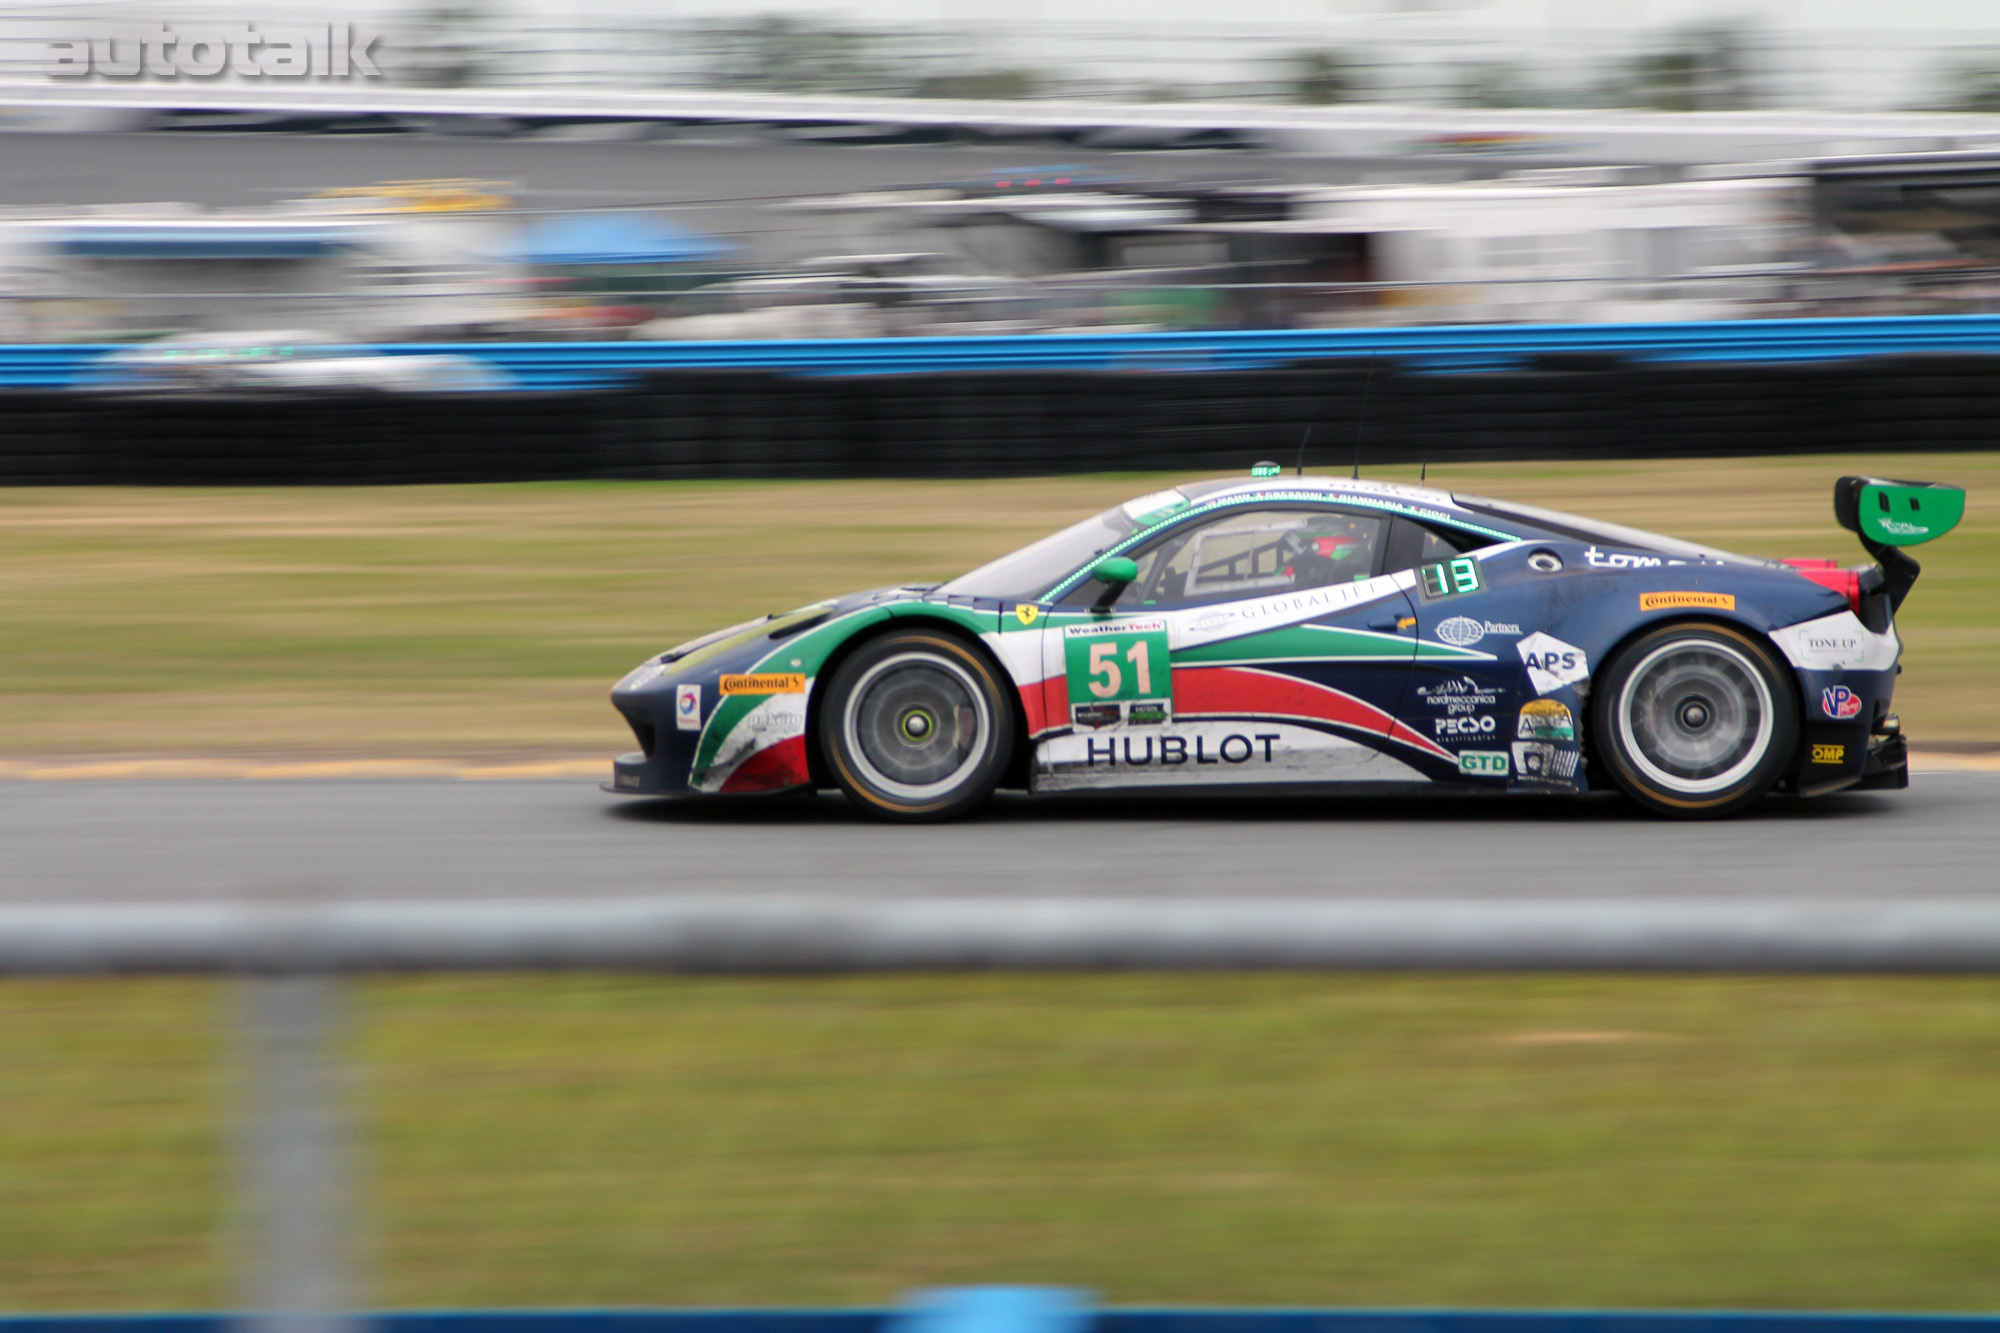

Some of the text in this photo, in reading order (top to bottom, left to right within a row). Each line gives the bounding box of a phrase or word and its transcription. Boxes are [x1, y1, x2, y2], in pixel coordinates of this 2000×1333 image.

[1645, 594, 1718, 607] Continental
[1068, 622, 1161, 635] WeatherTech
[1484, 620, 1520, 633] Partners
[1808, 638, 1857, 648] TONE UP
[1525, 652, 1576, 670] APS
[1088, 640, 1151, 698] 51
[723, 676, 790, 691] Continental
[1426, 694, 1496, 704] nordmeccanica
[1823, 686, 1851, 717] VP
[1447, 703, 1476, 715] group
[1435, 715, 1496, 735] PECSO
[1087, 733, 1281, 767] HUBLOT
[1811, 748, 1845, 761] OMP
[1461, 754, 1507, 771] GTD
